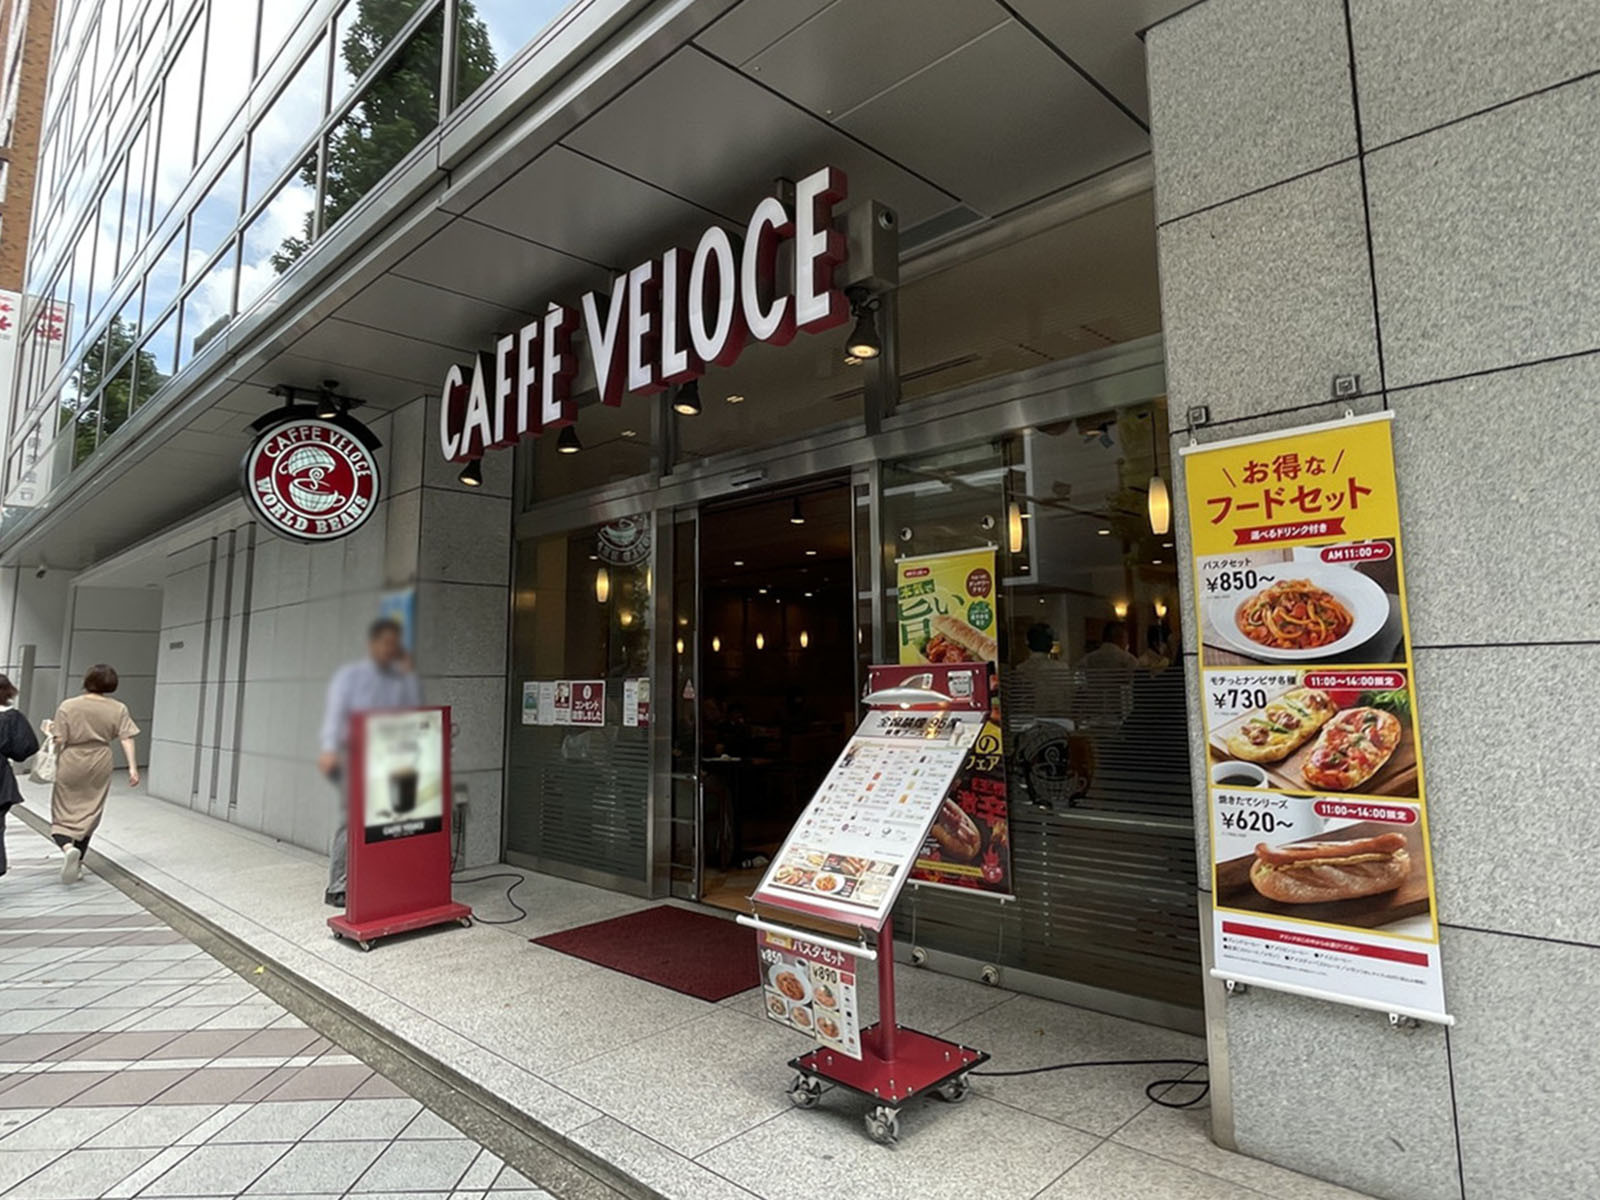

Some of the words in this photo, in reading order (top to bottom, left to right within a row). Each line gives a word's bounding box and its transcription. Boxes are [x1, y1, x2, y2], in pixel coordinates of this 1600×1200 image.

[581, 166, 832, 402] VELOCE
[329, 431, 373, 477] VELOCE
[1242, 453, 1327, 484] お得な
[256, 476, 308, 531] WORLD
[316, 495, 368, 533] BEANS
[1207, 477, 1373, 524] フードセット
[1213, 689, 1267, 709] ¥730
[978, 735, 999, 753] の
